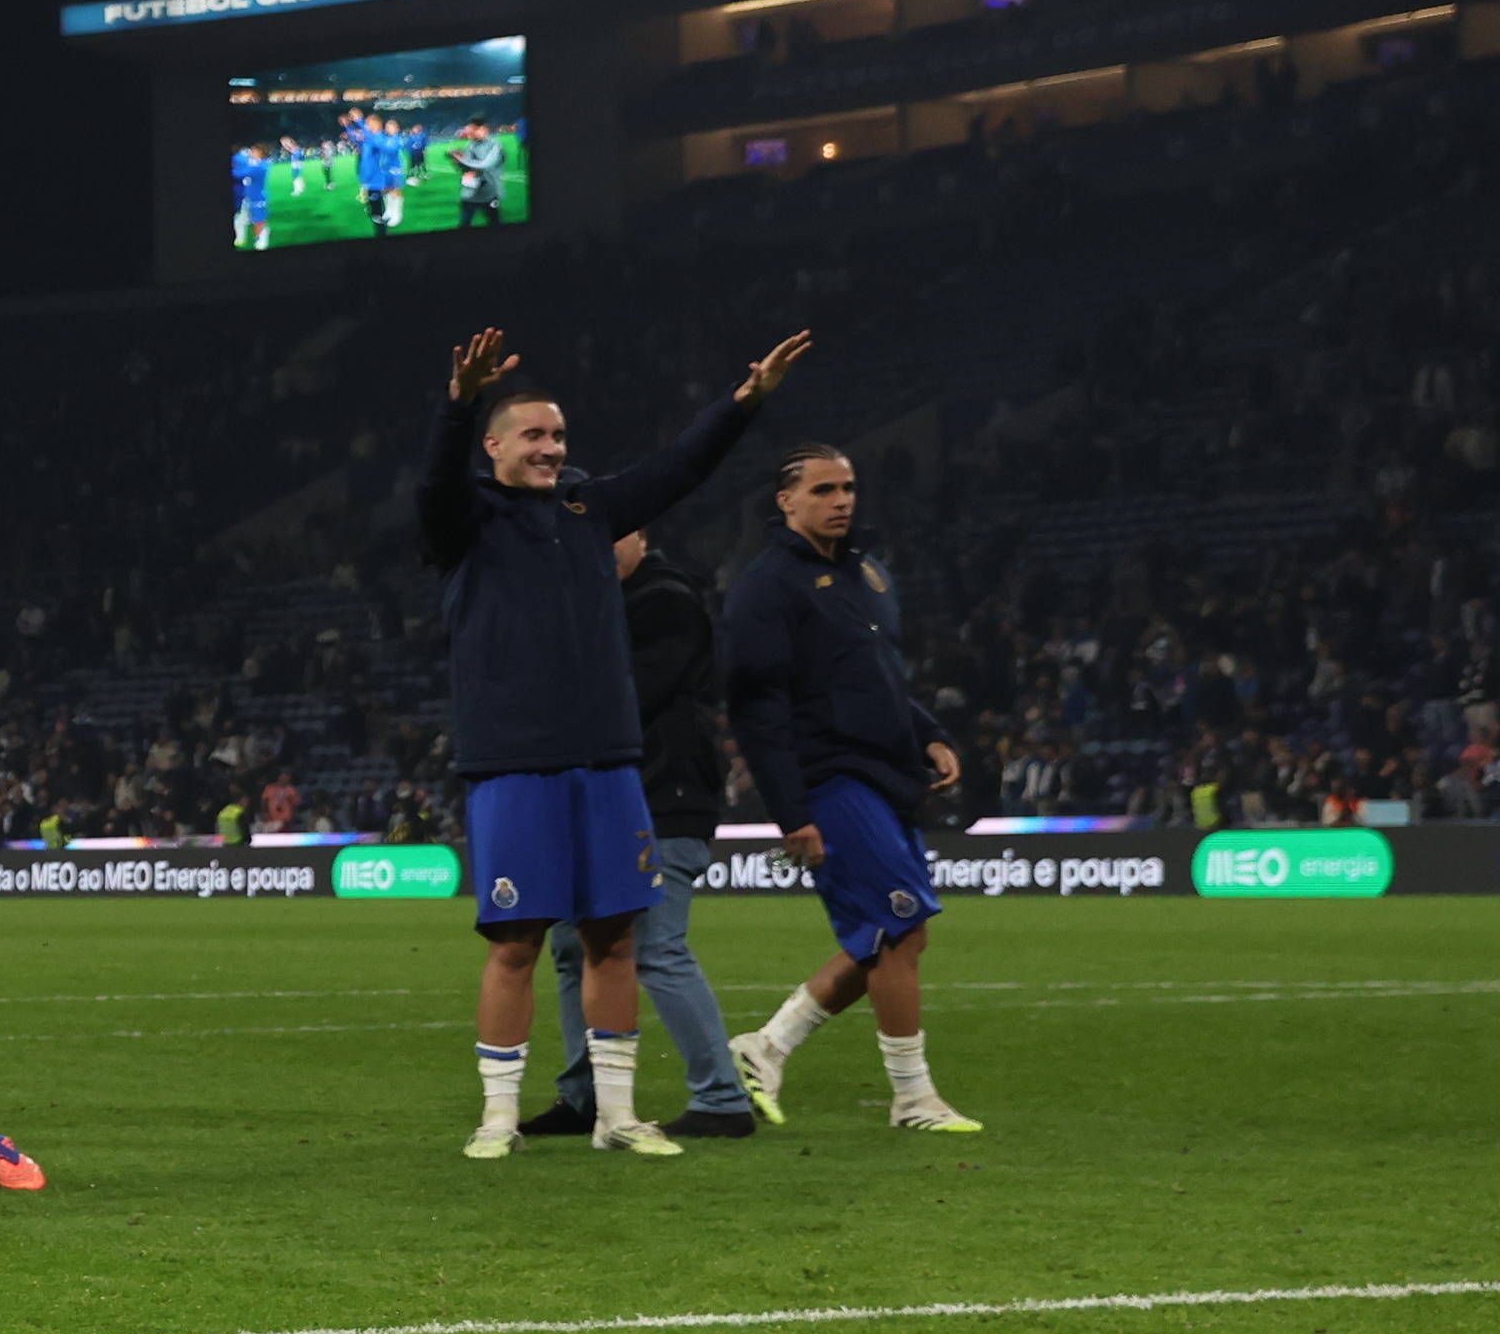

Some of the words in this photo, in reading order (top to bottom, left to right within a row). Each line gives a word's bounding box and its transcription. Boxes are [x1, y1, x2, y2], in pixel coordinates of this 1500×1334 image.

[15, 872, 30, 893] o
[31, 864, 74, 892] MEO
[77, 871, 102, 891] ao
[104, 863, 153, 892] MEO
[154, 859, 230, 898] Energia
[230, 869, 245, 891] e
[246, 867, 315, 897] poupa
[339, 859, 394, 890] MEO
[1032, 856, 1053, 887] e
[1060, 852, 1164, 897] poupa
[1205, 847, 1290, 888] MEO
[1299, 852, 1380, 879] energia
